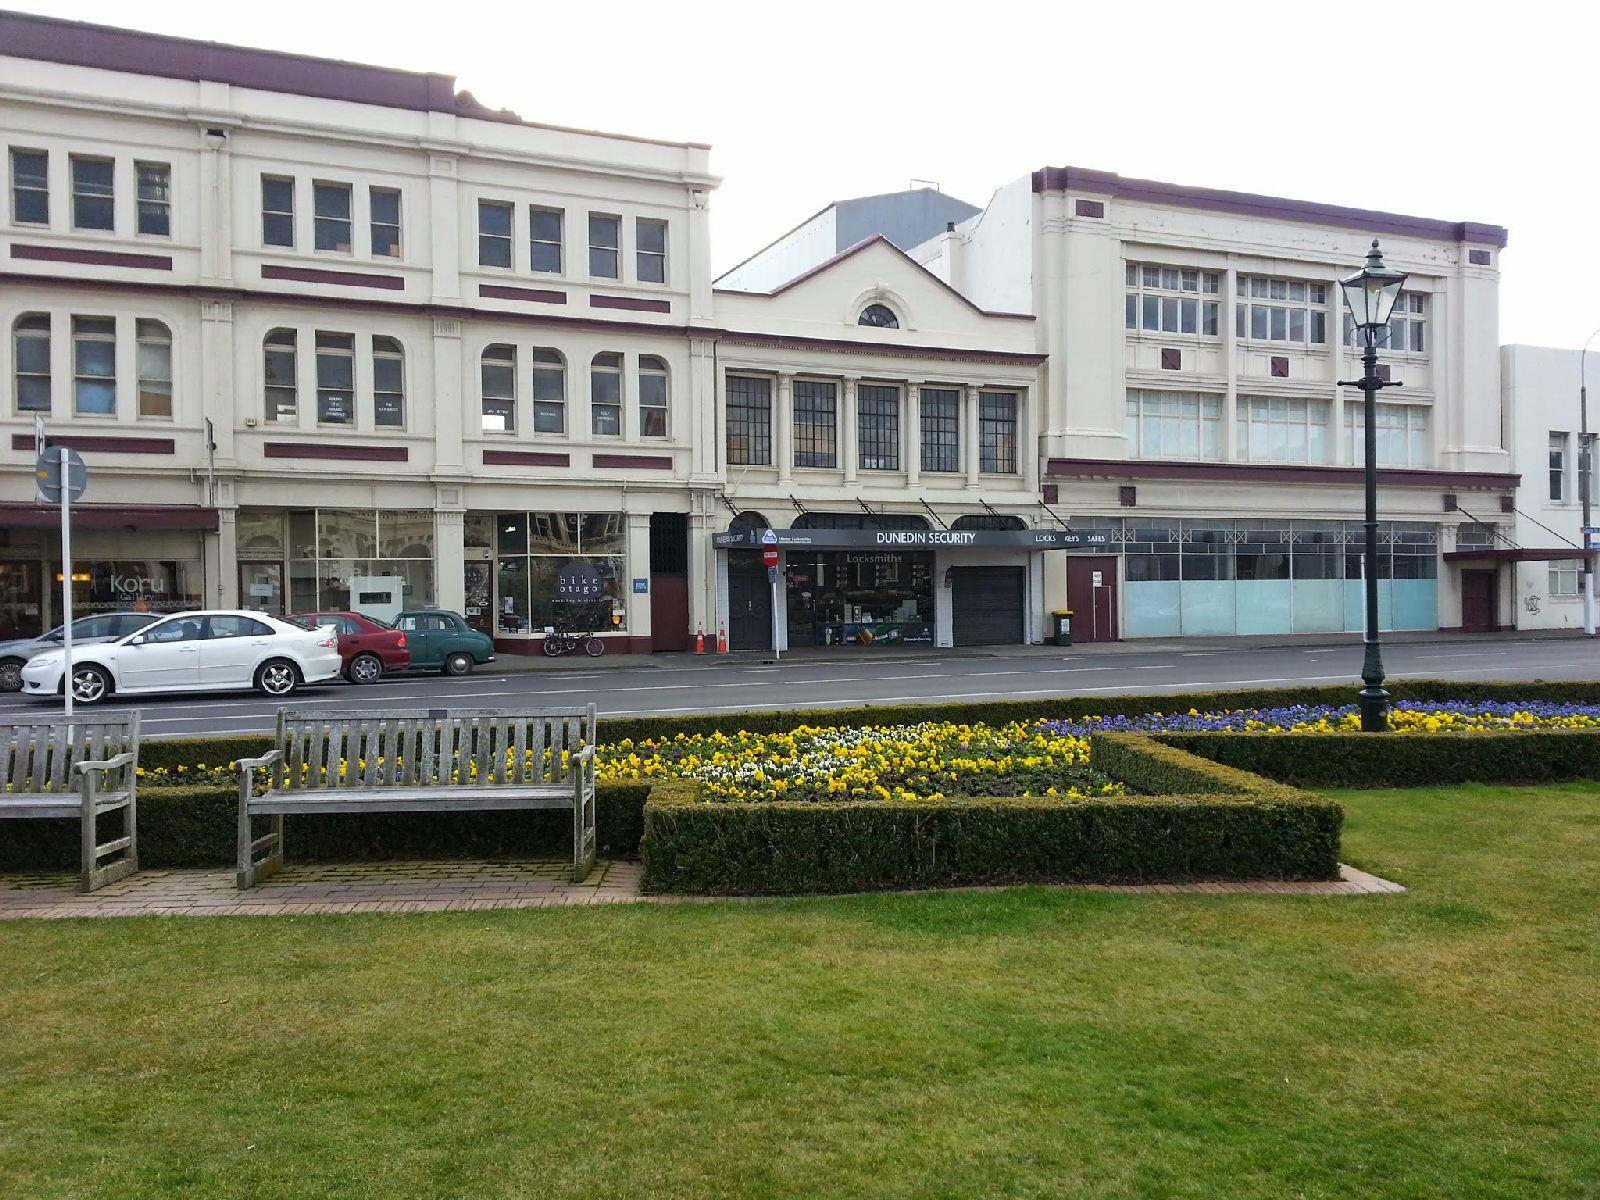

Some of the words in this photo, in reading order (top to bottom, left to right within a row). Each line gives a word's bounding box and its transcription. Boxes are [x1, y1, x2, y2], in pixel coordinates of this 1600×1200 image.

[876, 532, 926, 544] DUNEDIN
[928, 532, 976, 544] SECURITY
[1064, 534, 1080, 542] KEYS
[846, 553, 902, 563] Locksmiths
[110, 574, 164, 593] Koru
[559, 574, 598, 585] bike
[559, 585, 598, 594] otago
[120, 592, 154, 602] Gallry
